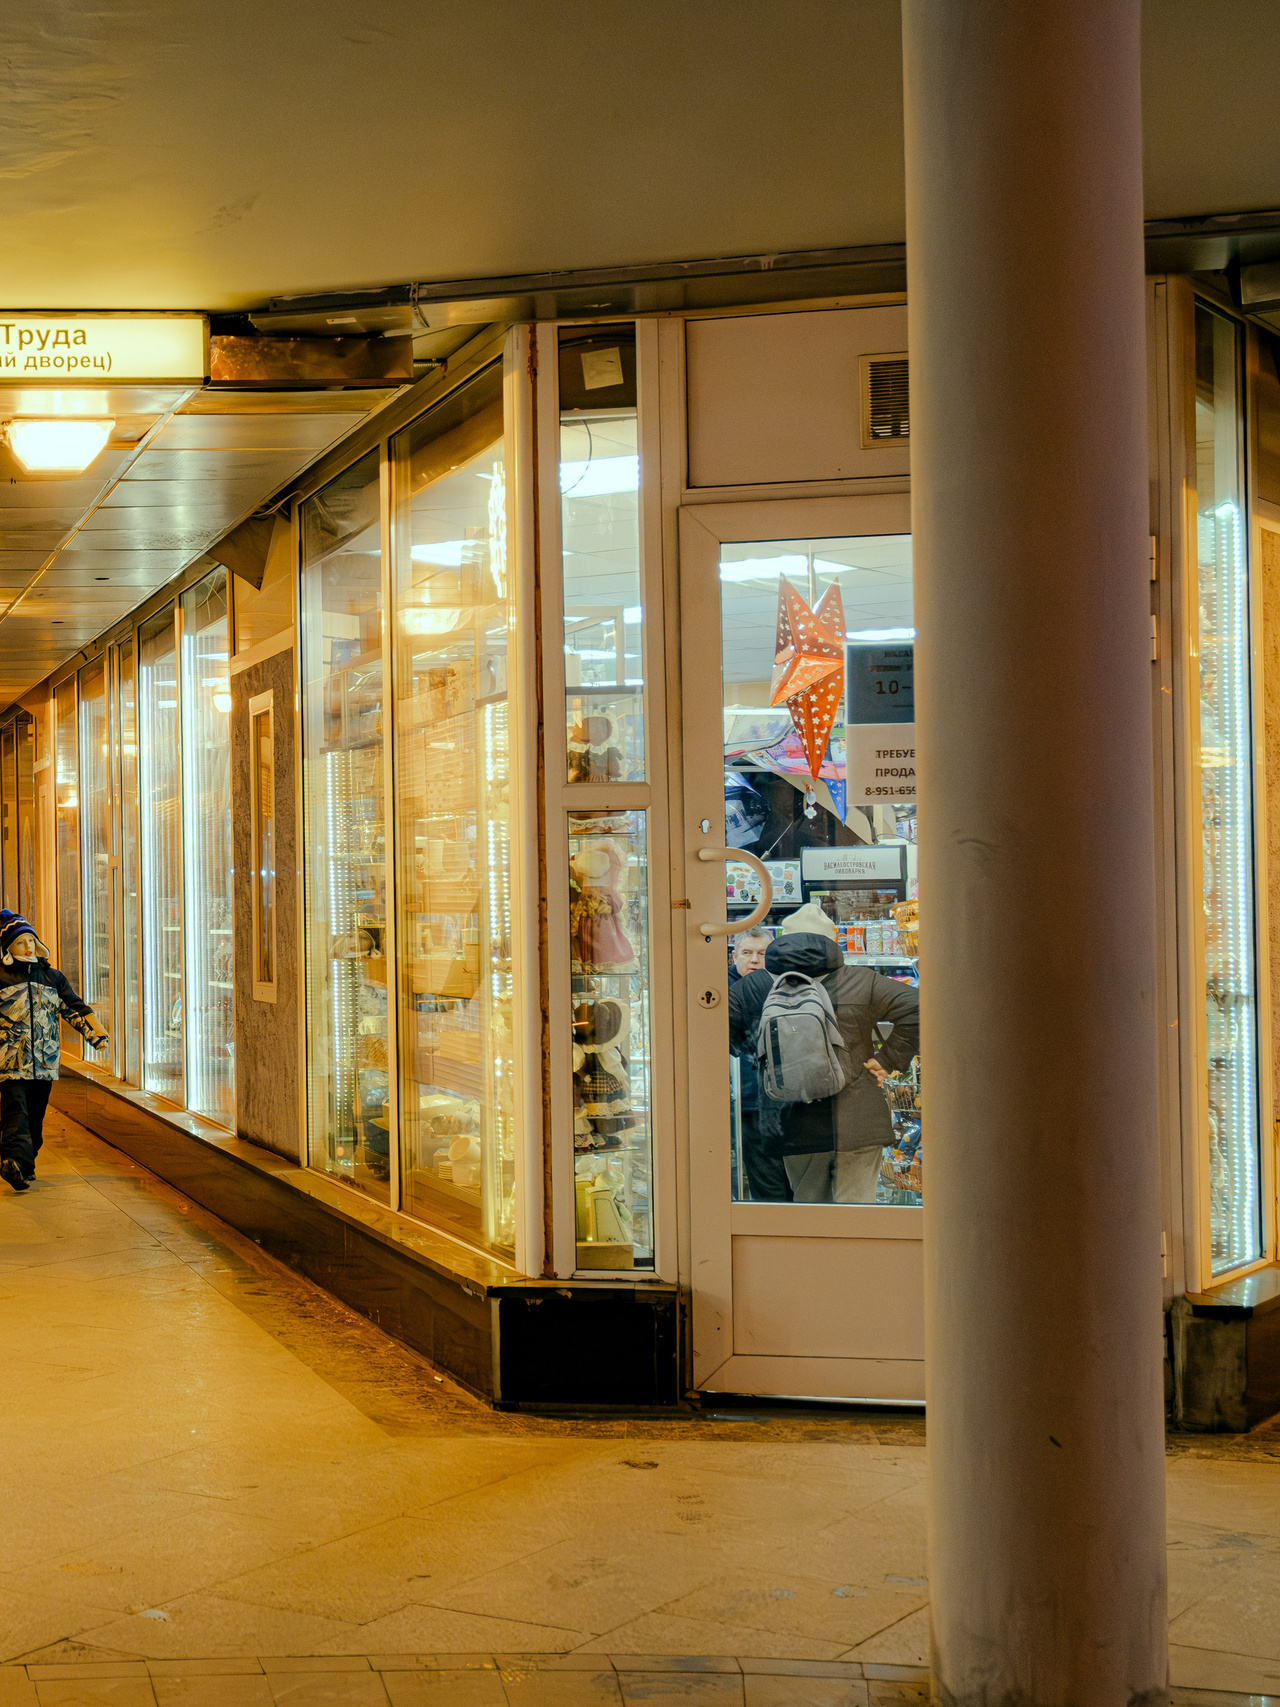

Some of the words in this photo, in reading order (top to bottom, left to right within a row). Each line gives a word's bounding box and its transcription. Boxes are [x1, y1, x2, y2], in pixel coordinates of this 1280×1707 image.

[0, 322, 87, 351] Труда
[24, 351, 112, 373] дворец)
[875, 748, 916, 759] ТРЕБУЕ
[875, 767, 916, 779] ПРОДА
